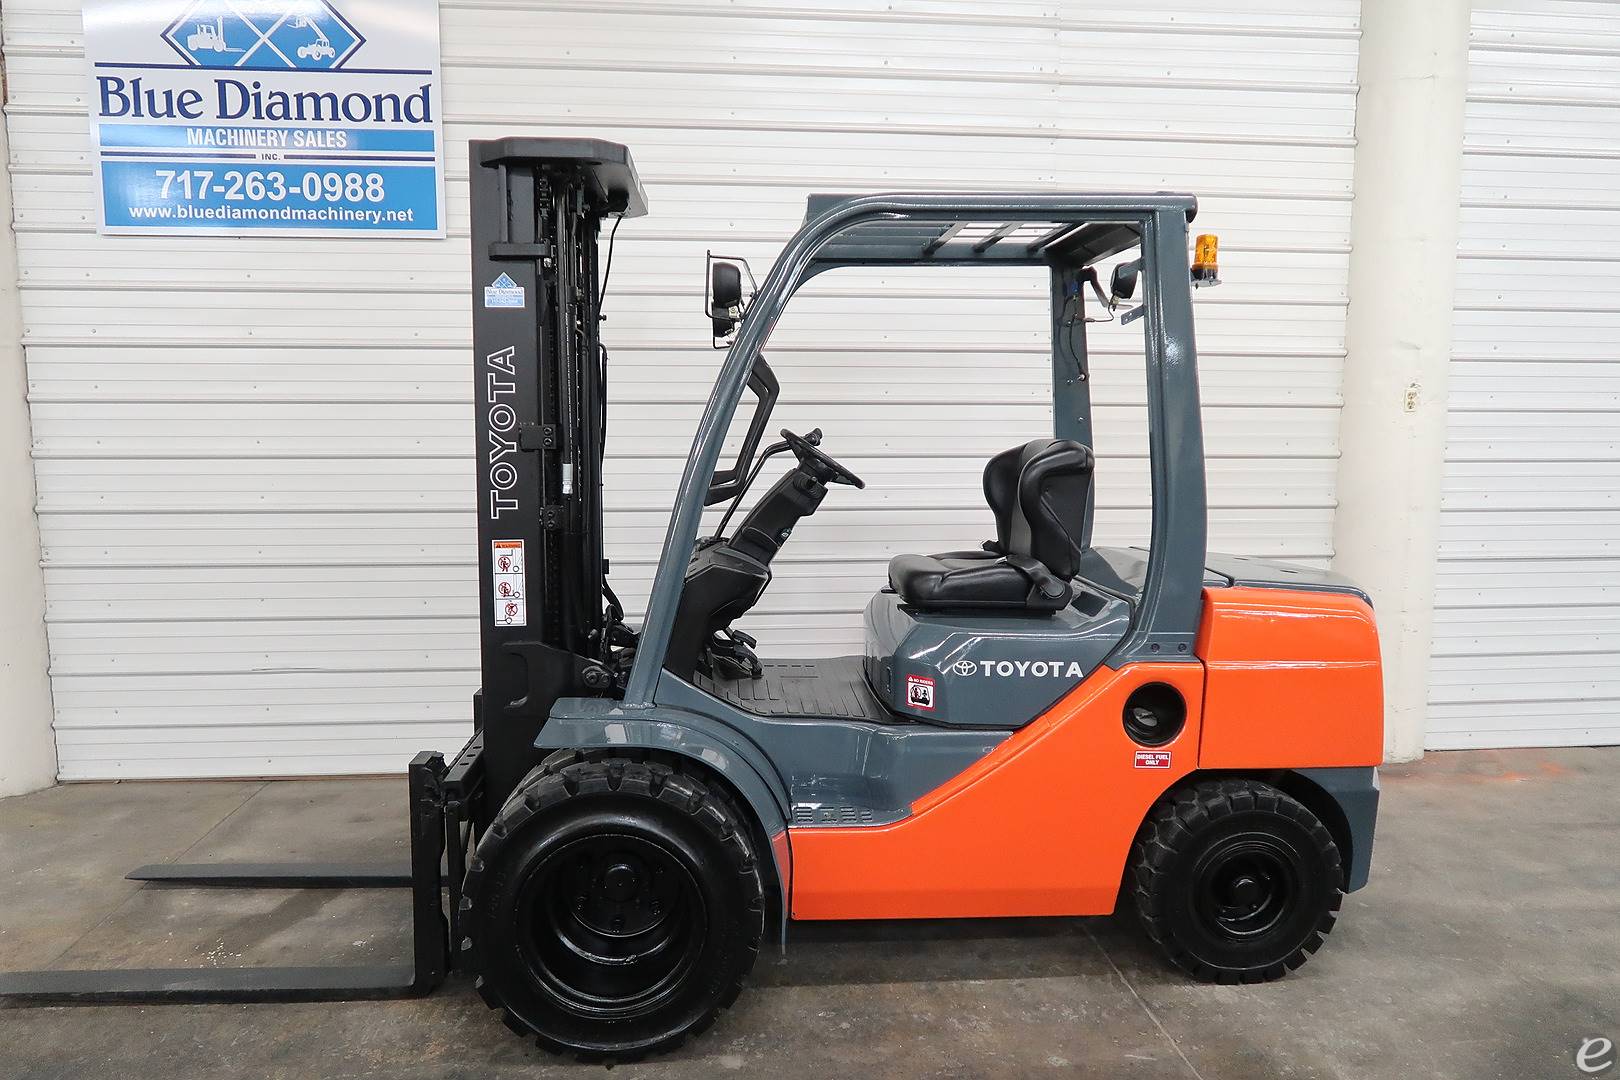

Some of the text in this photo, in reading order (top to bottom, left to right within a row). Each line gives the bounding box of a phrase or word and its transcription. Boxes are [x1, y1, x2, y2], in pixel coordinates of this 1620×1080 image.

[96, 76, 433, 123] Blue Diamond
[186, 128, 347, 149] MACHINERY SALES
[261, 153, 281, 161] INC.
[155, 169, 385, 202] 717-263-0988
[129, 205, 414, 224] www.bluediamondmachinery.net
[487, 346, 518, 519] TOYOTA
[980, 660, 1084, 678] TOYOTA
